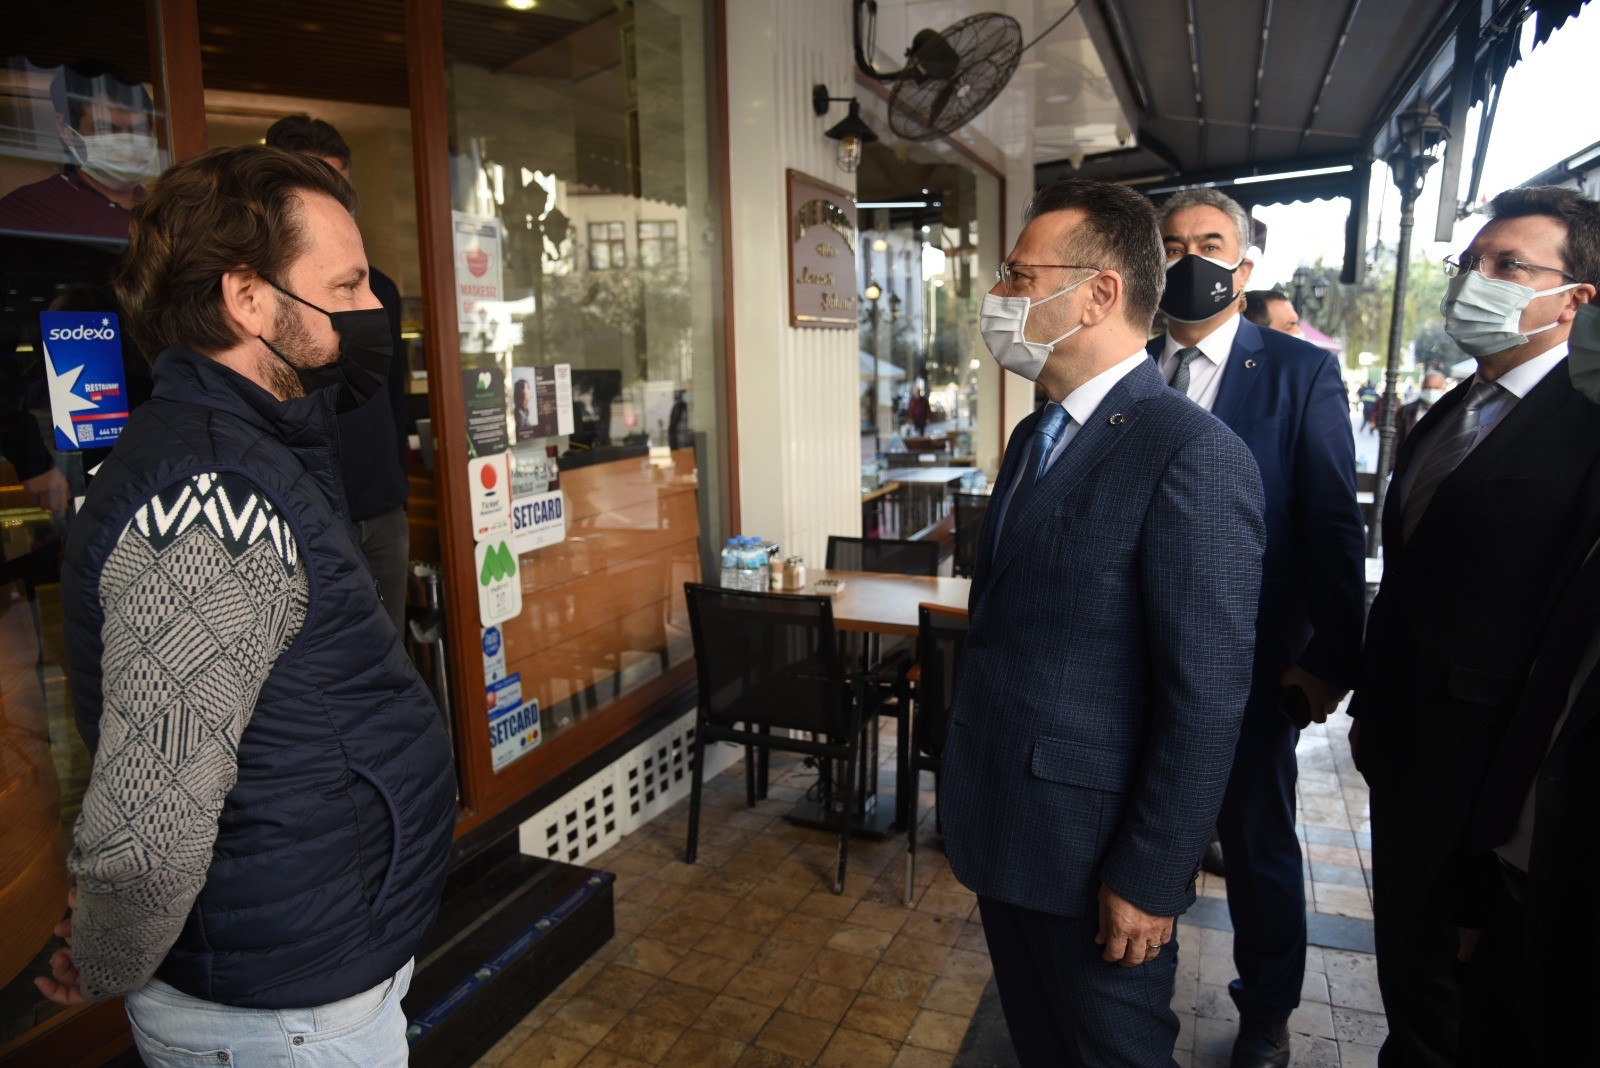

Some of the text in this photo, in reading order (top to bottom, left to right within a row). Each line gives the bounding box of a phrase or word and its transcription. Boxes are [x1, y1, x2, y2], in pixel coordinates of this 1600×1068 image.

[49, 324, 115, 340] sodexo
[481, 500, 500, 509] Ticket
[513, 497, 562, 530] SETCARD
[489, 703, 538, 748] SETCARD
